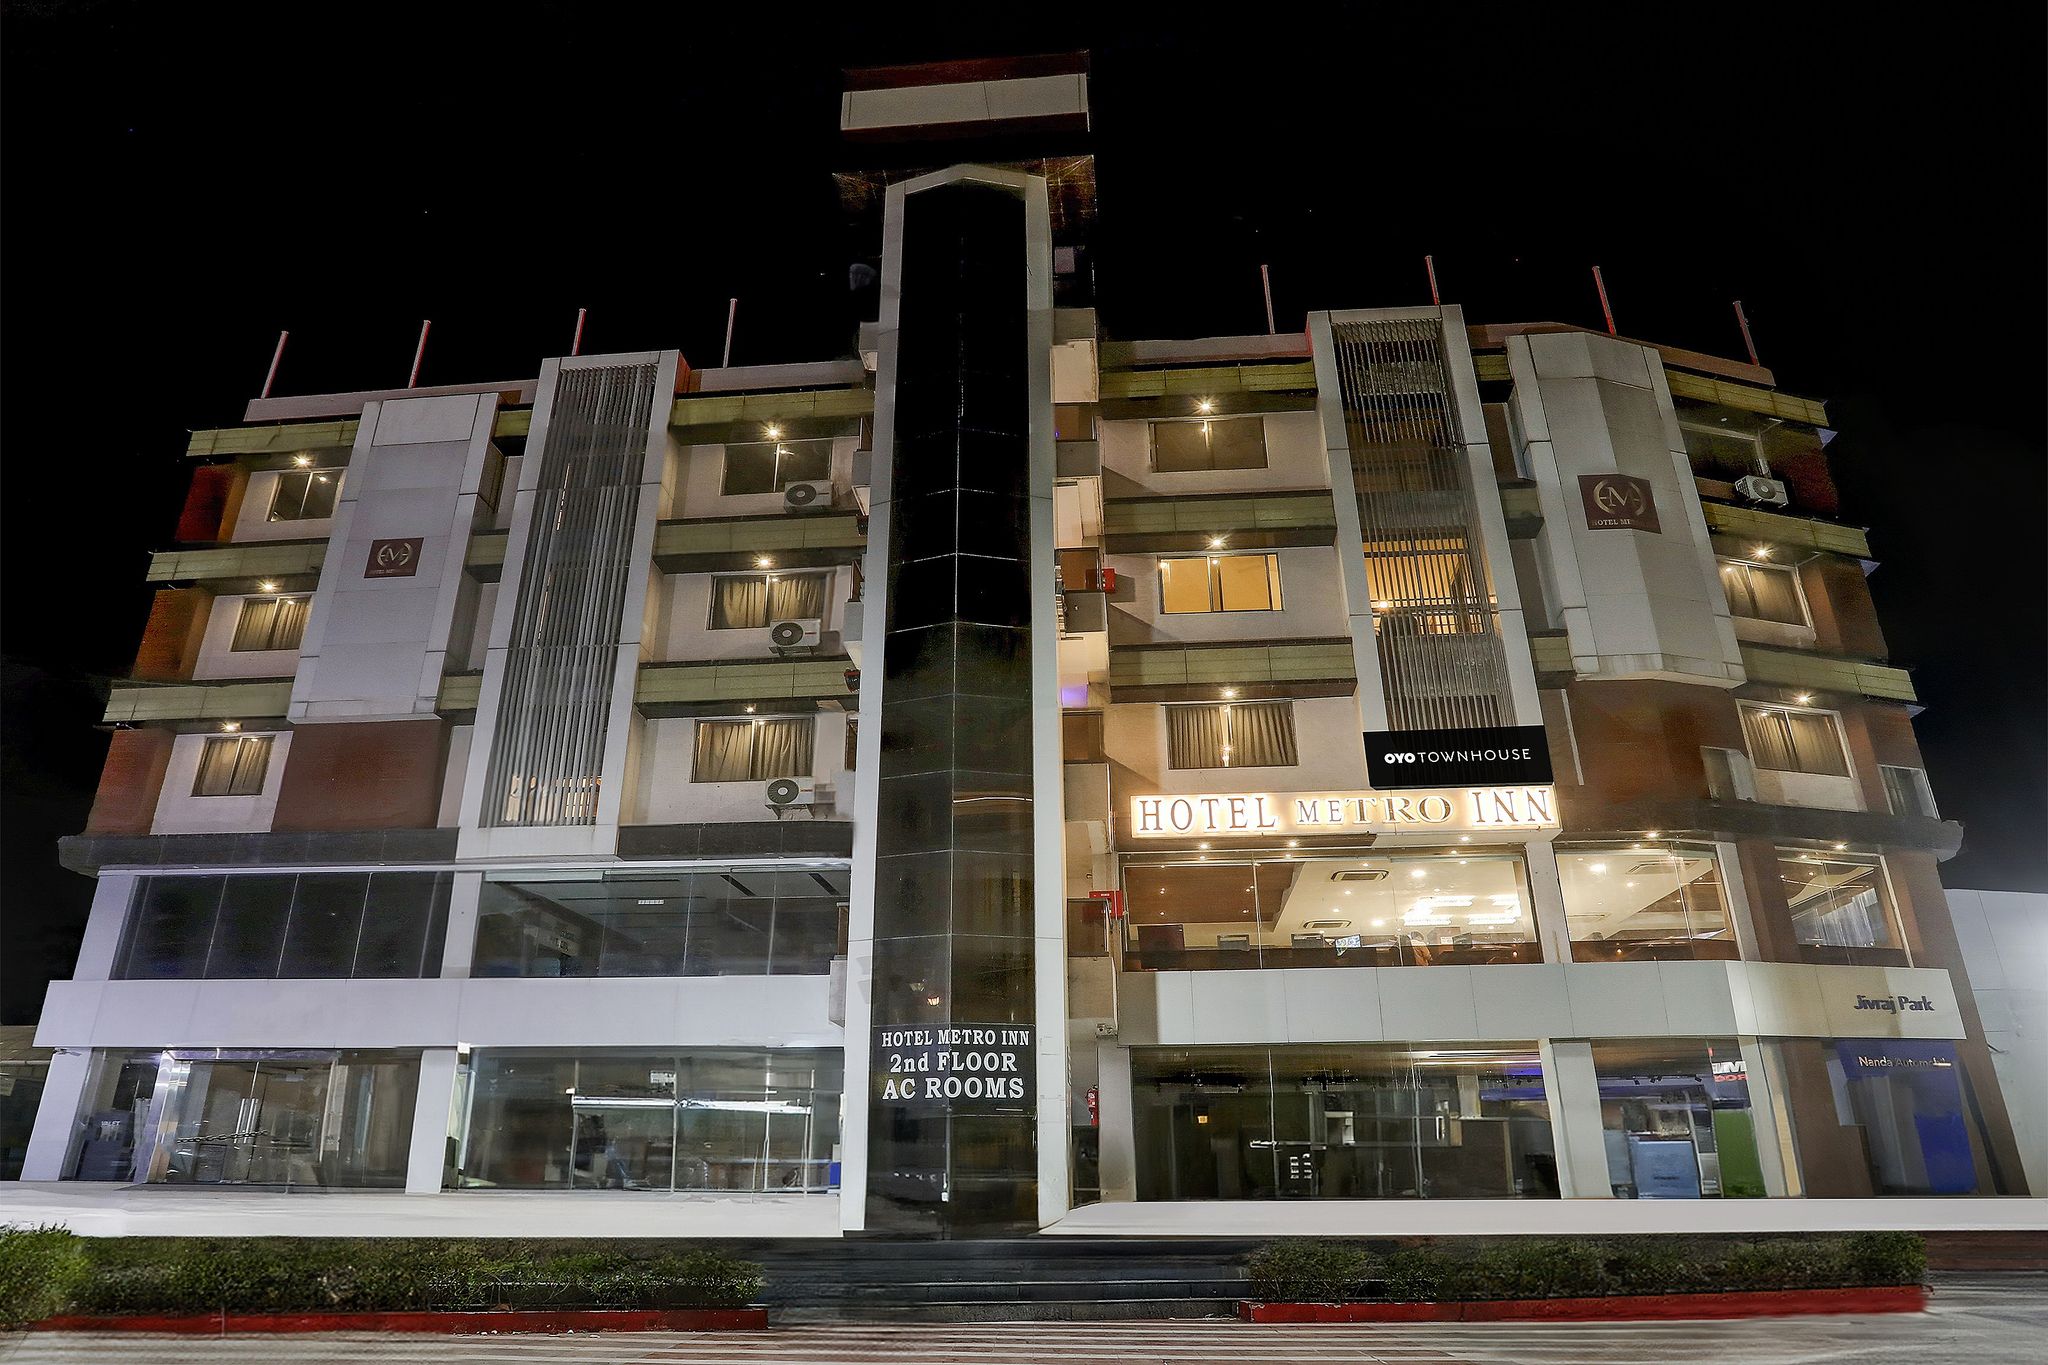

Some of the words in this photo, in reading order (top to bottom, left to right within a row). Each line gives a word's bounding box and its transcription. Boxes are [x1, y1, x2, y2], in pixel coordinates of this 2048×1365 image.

[1384, 752, 1416, 765] OYO
[1417, 748, 1532, 764] TOWNHOUSE
[1138, 797, 1277, 832] HOTEL
[1297, 796, 1454, 825] METRO
[1471, 789, 1552, 824] INN
[1854, 994, 1897, 1015] Jivraj
[1898, 995, 1935, 1011] Park
[881, 1030, 933, 1047] HOTEL
[937, 1029, 996, 1046] METRO
[1001, 1030, 1030, 1046] INN
[890, 1052, 929, 1073] 2nd
[937, 1051, 1018, 1072] FLOOR
[1858, 1056, 1893, 1067] Nanda
[882, 1078, 916, 1100] AC
[925, 1076, 1025, 1099] ROOMS
